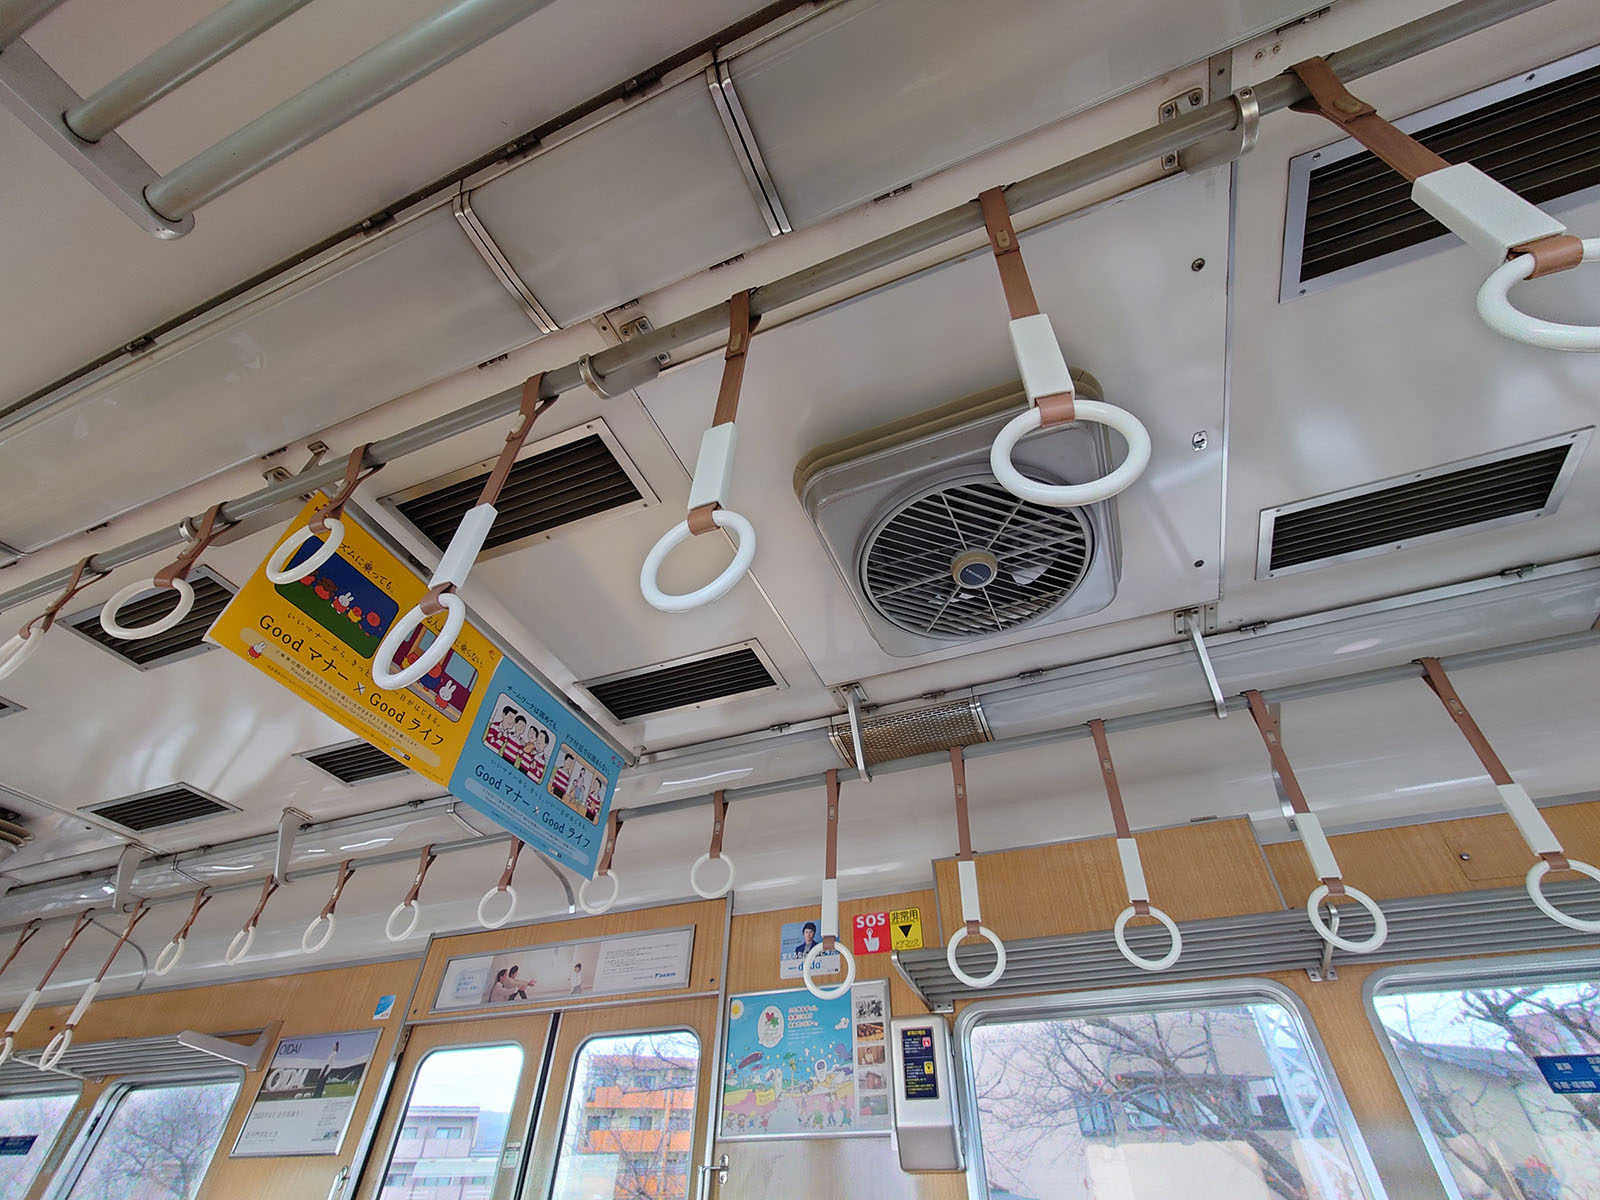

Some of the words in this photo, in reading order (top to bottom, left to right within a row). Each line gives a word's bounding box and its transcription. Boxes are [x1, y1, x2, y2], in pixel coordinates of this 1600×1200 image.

[339, 542, 395, 594] ズムに乗っても。
[259, 614, 303, 652] Good
[308, 647, 349, 682] マナー
[369, 692, 406, 723] Good
[408, 718, 444, 746] ライフ
[475, 764, 502, 790] Good
[504, 784, 530, 806] マナー
[542, 811, 565, 833] Good
[567, 828, 590, 848] ライフ
[856, 913, 885, 928] SOS
[891, 910, 918, 921] 非常用
[798, 960, 821, 971] dda
